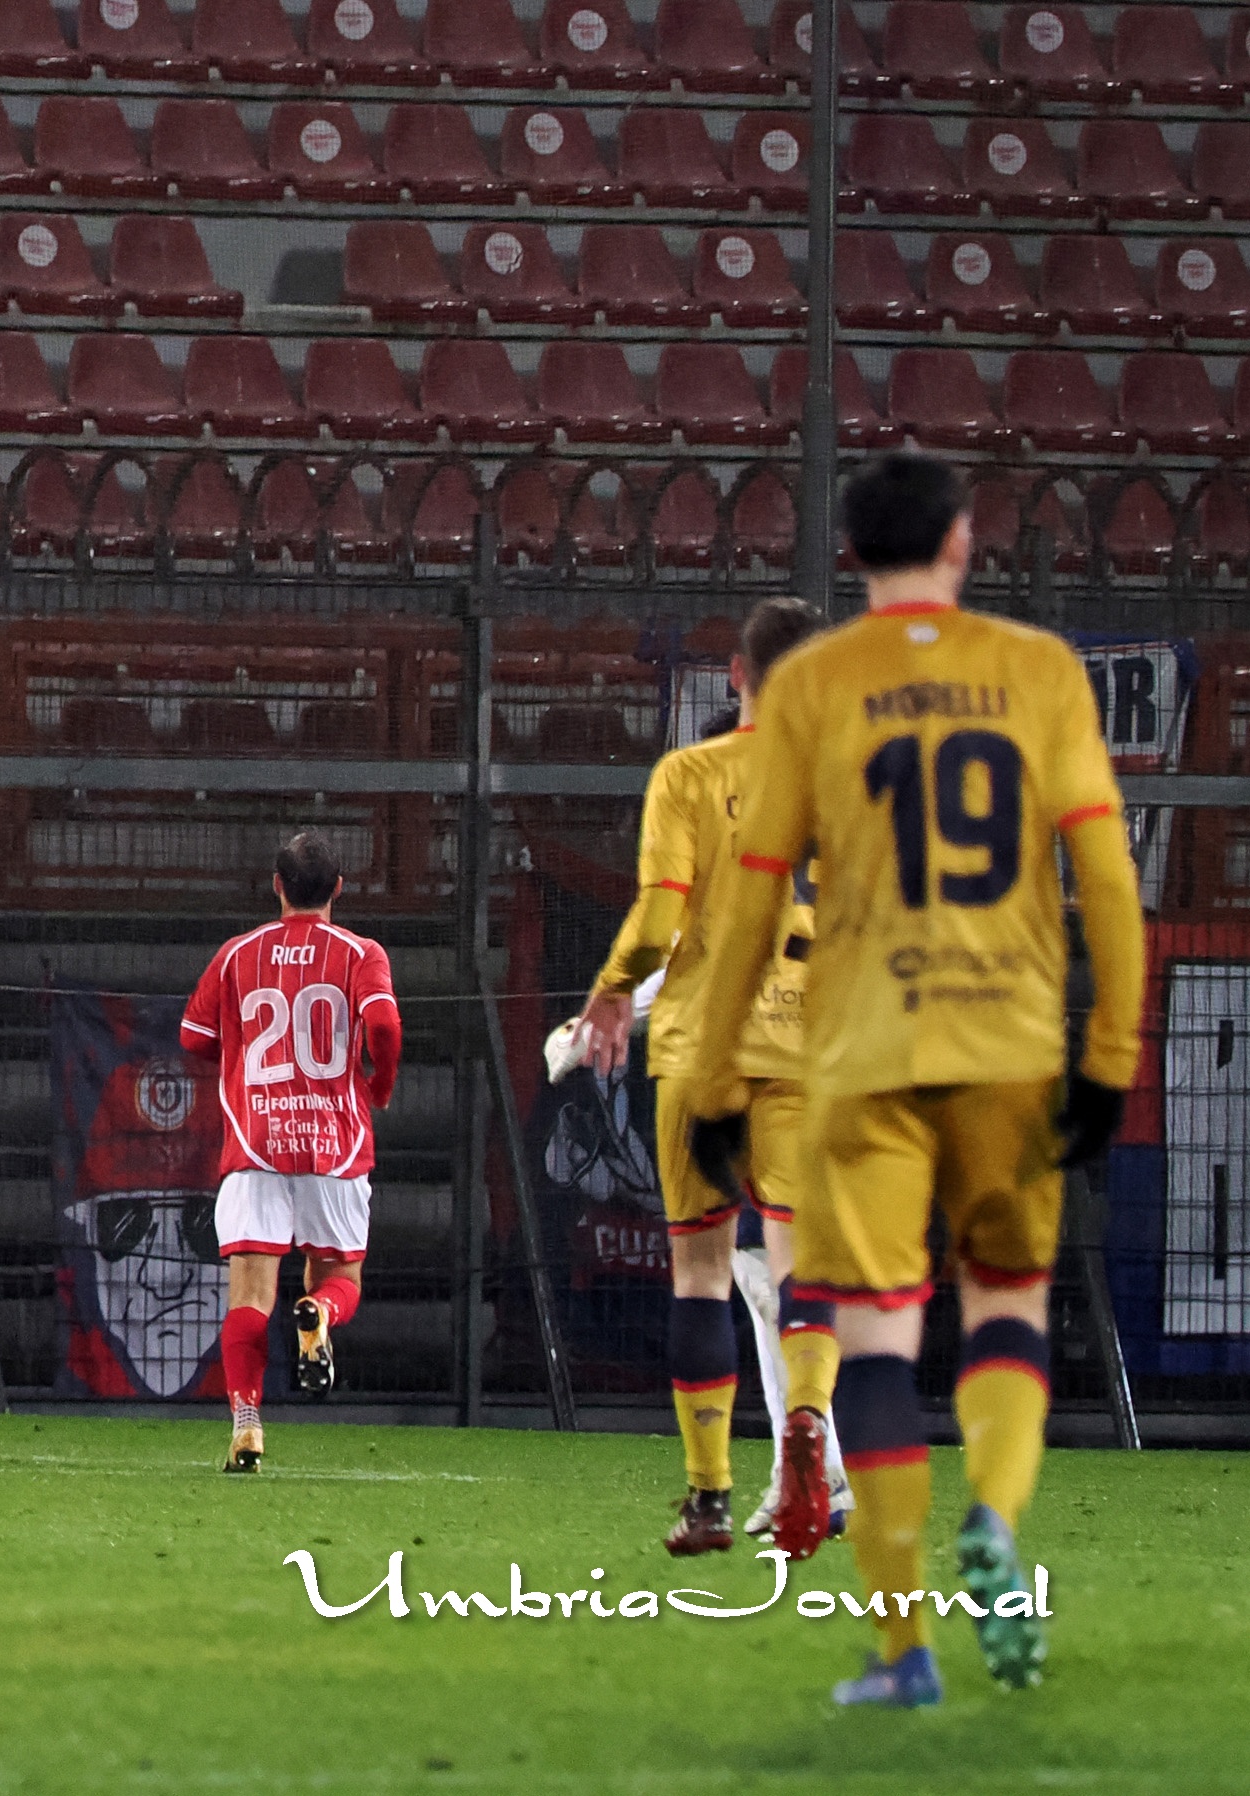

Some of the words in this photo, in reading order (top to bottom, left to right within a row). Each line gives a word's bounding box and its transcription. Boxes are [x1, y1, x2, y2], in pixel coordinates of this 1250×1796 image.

[862, 728, 1024, 911] 19
[270, 944, 316, 966] RICCI
[241, 983, 350, 1087] 20
[265, 1136, 342, 1156] PERUGIA
